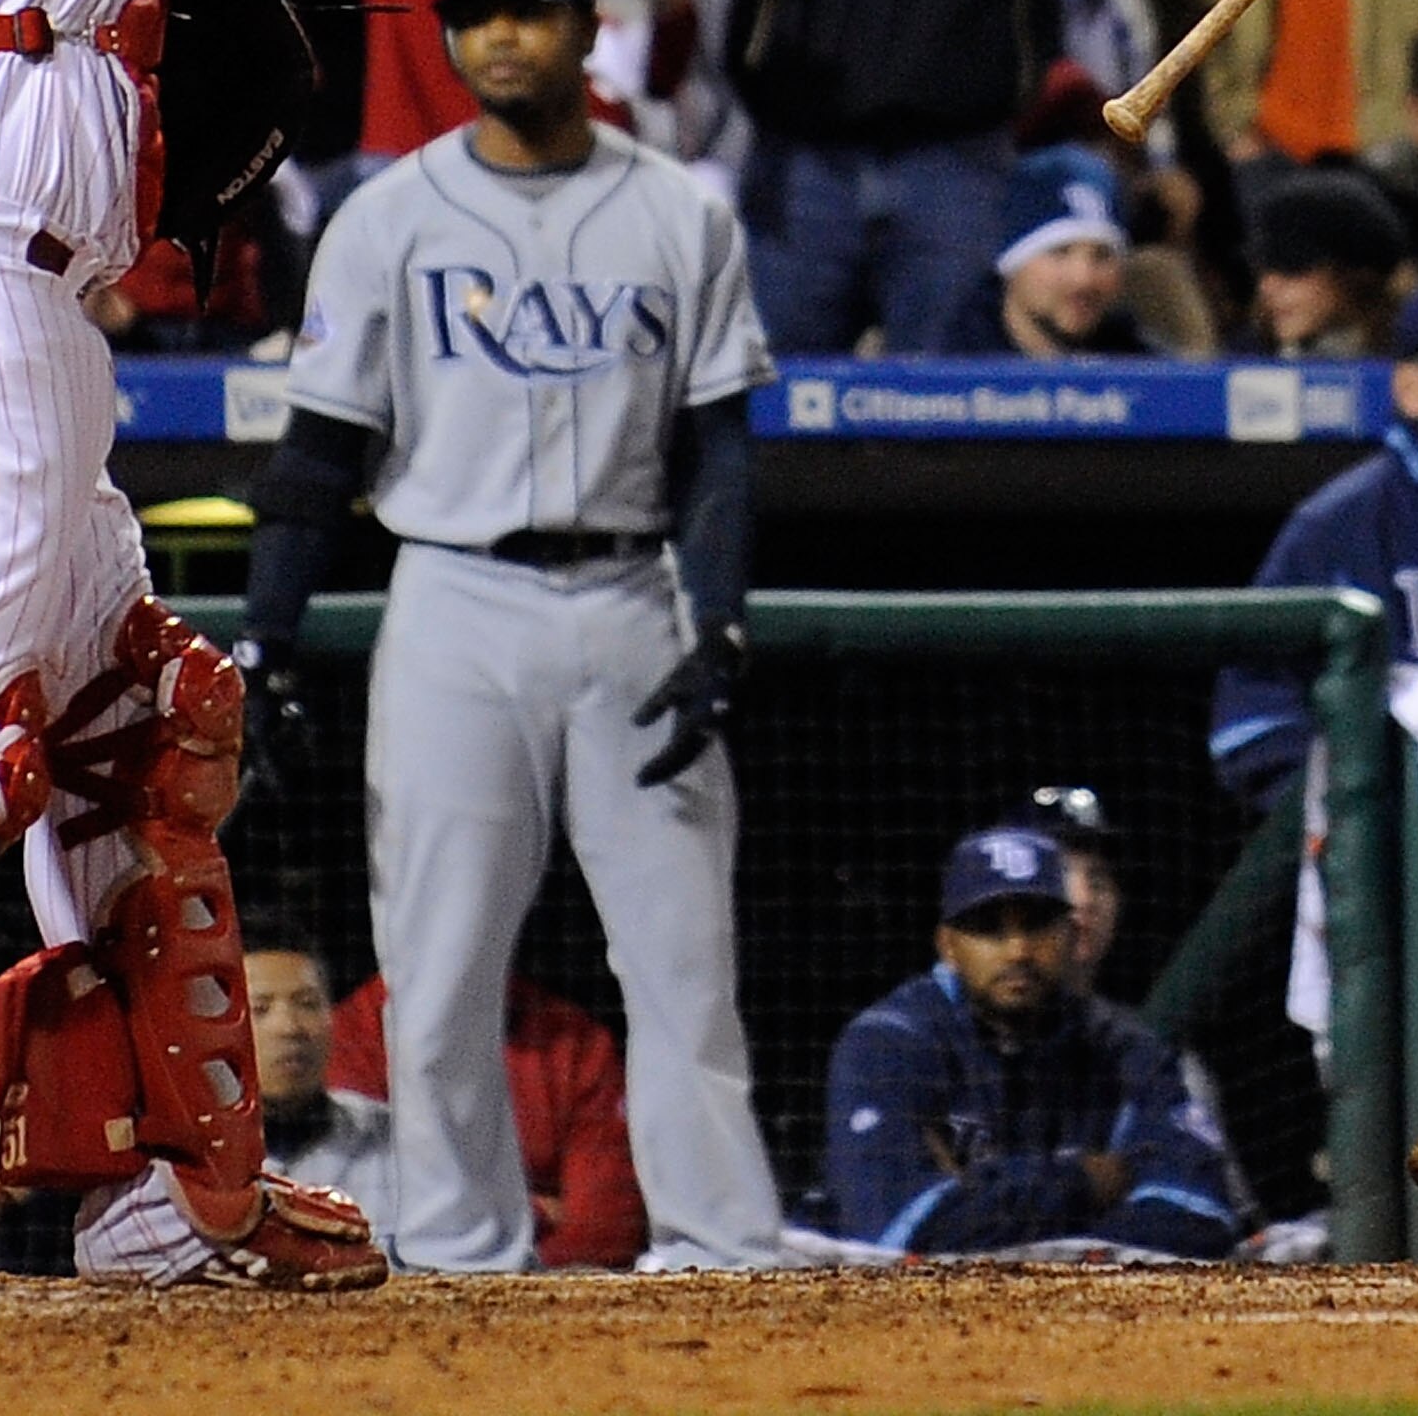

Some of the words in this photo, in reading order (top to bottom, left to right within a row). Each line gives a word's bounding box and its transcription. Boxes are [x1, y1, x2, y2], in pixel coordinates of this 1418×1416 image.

[216, 127, 285, 205] EASTON
[841, 387, 969, 423] Citizens
[973, 386, 1050, 423] Bank
[1054, 385, 1130, 424] Park
[1, 1114, 28, 1171] 51
